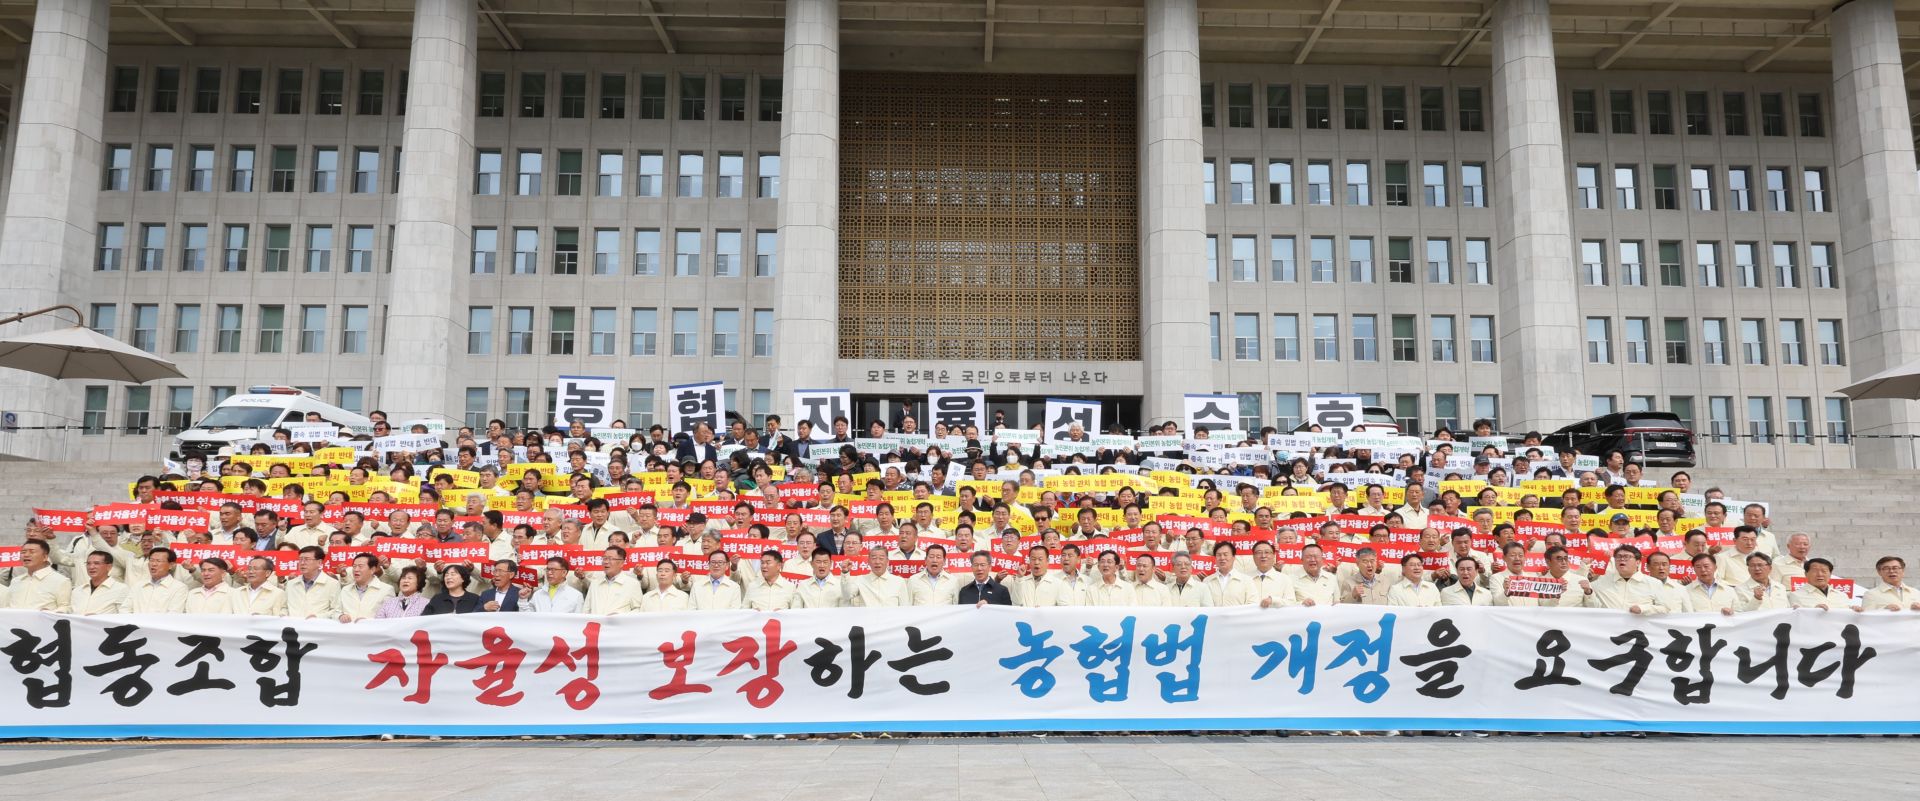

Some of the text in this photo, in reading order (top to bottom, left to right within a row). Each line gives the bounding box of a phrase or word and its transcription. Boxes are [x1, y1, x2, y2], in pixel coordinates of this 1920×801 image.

[867, 369, 1108, 384] 모든 권력은 국민으로부터 나온다
[563, 382, 605, 424] 농
[677, 389, 717, 432] 협
[802, 396, 844, 438] 자
[1052, 407, 1093, 441] 성
[324, 430, 337, 438] 반대
[271, 444, 284, 452] 반대
[399, 439, 415, 448] 반대
[878, 442, 898, 450] 농협개혁
[1240, 453, 1251, 461] 입법
[463, 476, 478, 485] 반대
[648, 476, 662, 484] 농협
[1046, 479, 1075, 488] 관치 농협
[1078, 479, 1123, 488] 관치 농협 반대
[1152, 475, 1165, 483] 관치
[1343, 477, 1355, 485] 입법
[779, 488, 812, 497] 농협 자율성
[975, 485, 988, 493] 농협
[1441, 485, 1471, 493] 관치 농협
[1541, 484, 1554, 492] 농협
[239, 499, 254, 508] 수호
[492, 500, 506, 509] 관치
[618, 496, 638, 505] 자율성
[943, 500, 957, 509] 반대
[1151, 500, 1199, 510] 관치 농협 반대
[420, 509, 436, 517] 수호
[565, 509, 585, 518] 자율성
[693, 505, 728, 514] 농협 자율성
[851, 505, 865, 514] 농협
[95, 509, 138, 521] 농협 자율성
[663, 512, 684, 521] 자율성
[760, 513, 782, 522] 자율성
[1061, 513, 1109, 521] 관치 반대
[1535, 513, 1549, 521] 농협
[63, 515, 83, 526] 수호
[148, 515, 206, 526] 농협 자율성 수호
[528, 516, 542, 524] 수호
[942, 516, 991, 525] 관치 반대
[1348, 520, 1369, 529] 자율성
[1580, 519, 1595, 527] 농협
[1159, 520, 1173, 530] 농협
[1173, 520, 1194, 530] 자율성
[1430, 521, 1444, 529] 농협
[1681, 523, 1694, 532] 농협
[1517, 526, 1532, 535] 농협
[1398, 533, 1420, 543] 자율성
[1708, 532, 1721, 541] 농협
[377, 543, 416, 553] 농협 자율성
[723, 542, 762, 553] 농협 자율성
[884, 542, 898, 551] 수호
[1472, 539, 1487, 548] 농협
[1635, 541, 1651, 550] 수호
[1660, 541, 1683, 550] 자율성
[426, 548, 486, 558] 농협 자율성 수호
[1096, 544, 1120, 553] 자율성
[1381, 548, 1404, 558] 자율성
[174, 549, 221, 559] 농협 자율성
[331, 551, 346, 561] 농협
[522, 550, 563, 560] 농협 자율성
[640, 551, 664, 561] 자율성
[1279, 549, 1294, 558] 농협
[570, 557, 585, 566] 농협
[687, 560, 709, 569] 자율성
[996, 559, 1019, 570] 자율성
[1191, 560, 1213, 571] 자율성
[1590, 560, 1606, 570] 수호
[896, 566, 916, 574] 자율성
[0, 613, 1877, 711] 협동조합 자율성 보장하는 농협법 개정을 요구합니다
